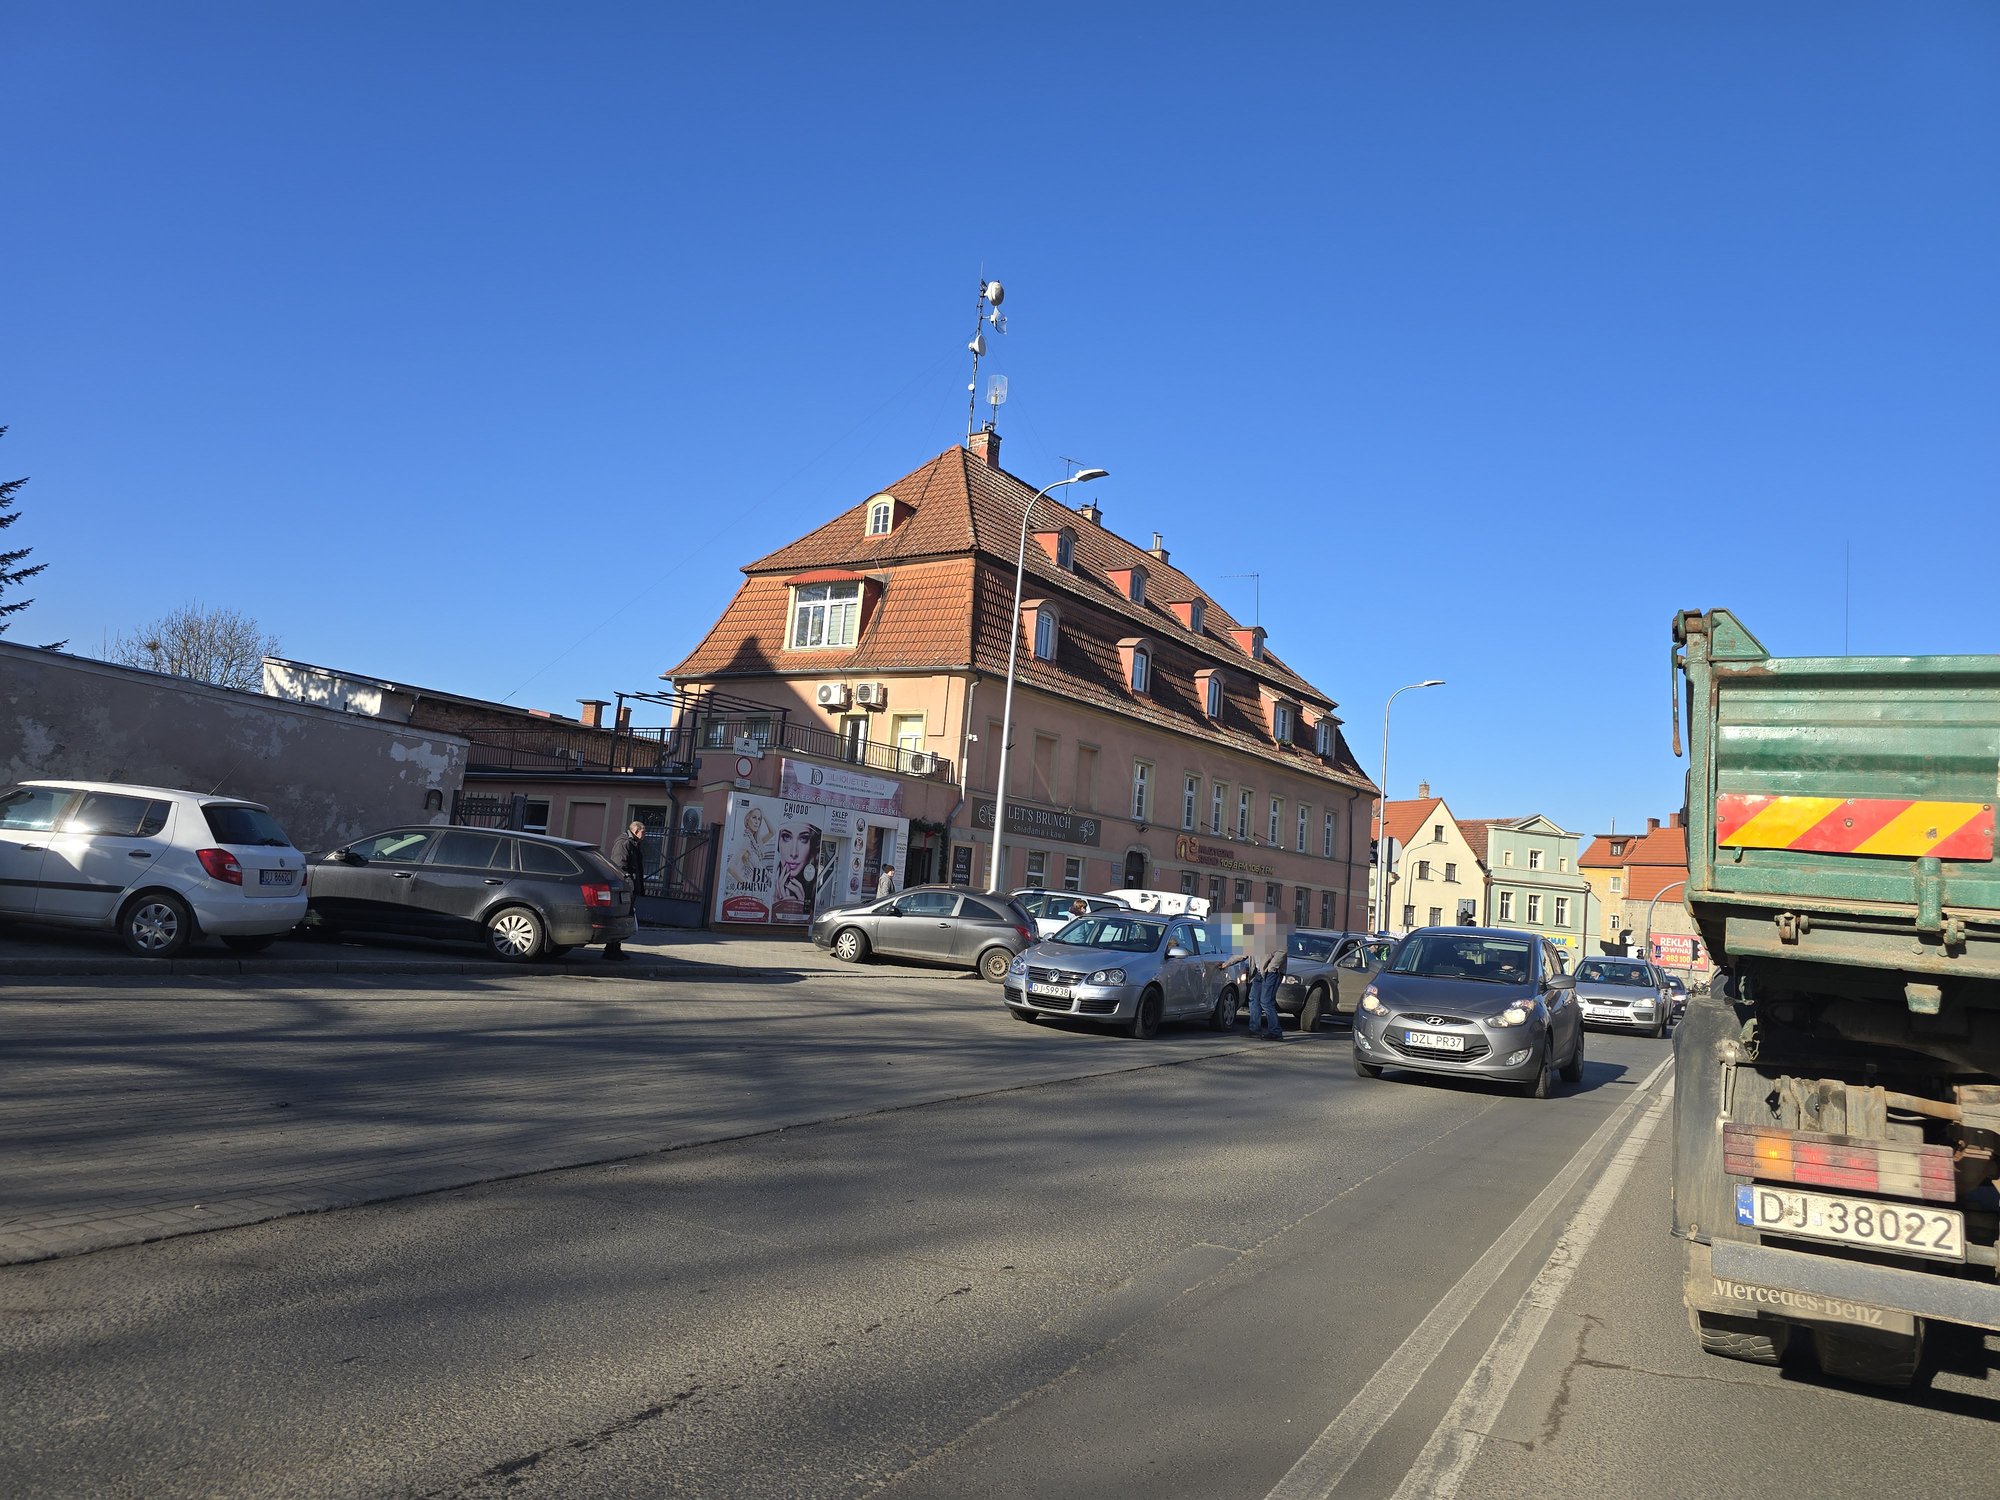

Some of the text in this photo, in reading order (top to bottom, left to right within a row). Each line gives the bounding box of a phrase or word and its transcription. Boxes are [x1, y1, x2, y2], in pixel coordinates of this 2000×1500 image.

[832, 810, 849, 819] SKLEP
[1008, 806, 1071, 829] LET'S BRUNCH
[1660, 938, 1702, 949] REKLA
[1411, 1033, 1462, 1048] DZL PR37
[1739, 1207, 1752, 1219] PL
[1760, 1191, 1953, 1251] DJ 38022
[1711, 1277, 1884, 1327] Mercedes-Benz
